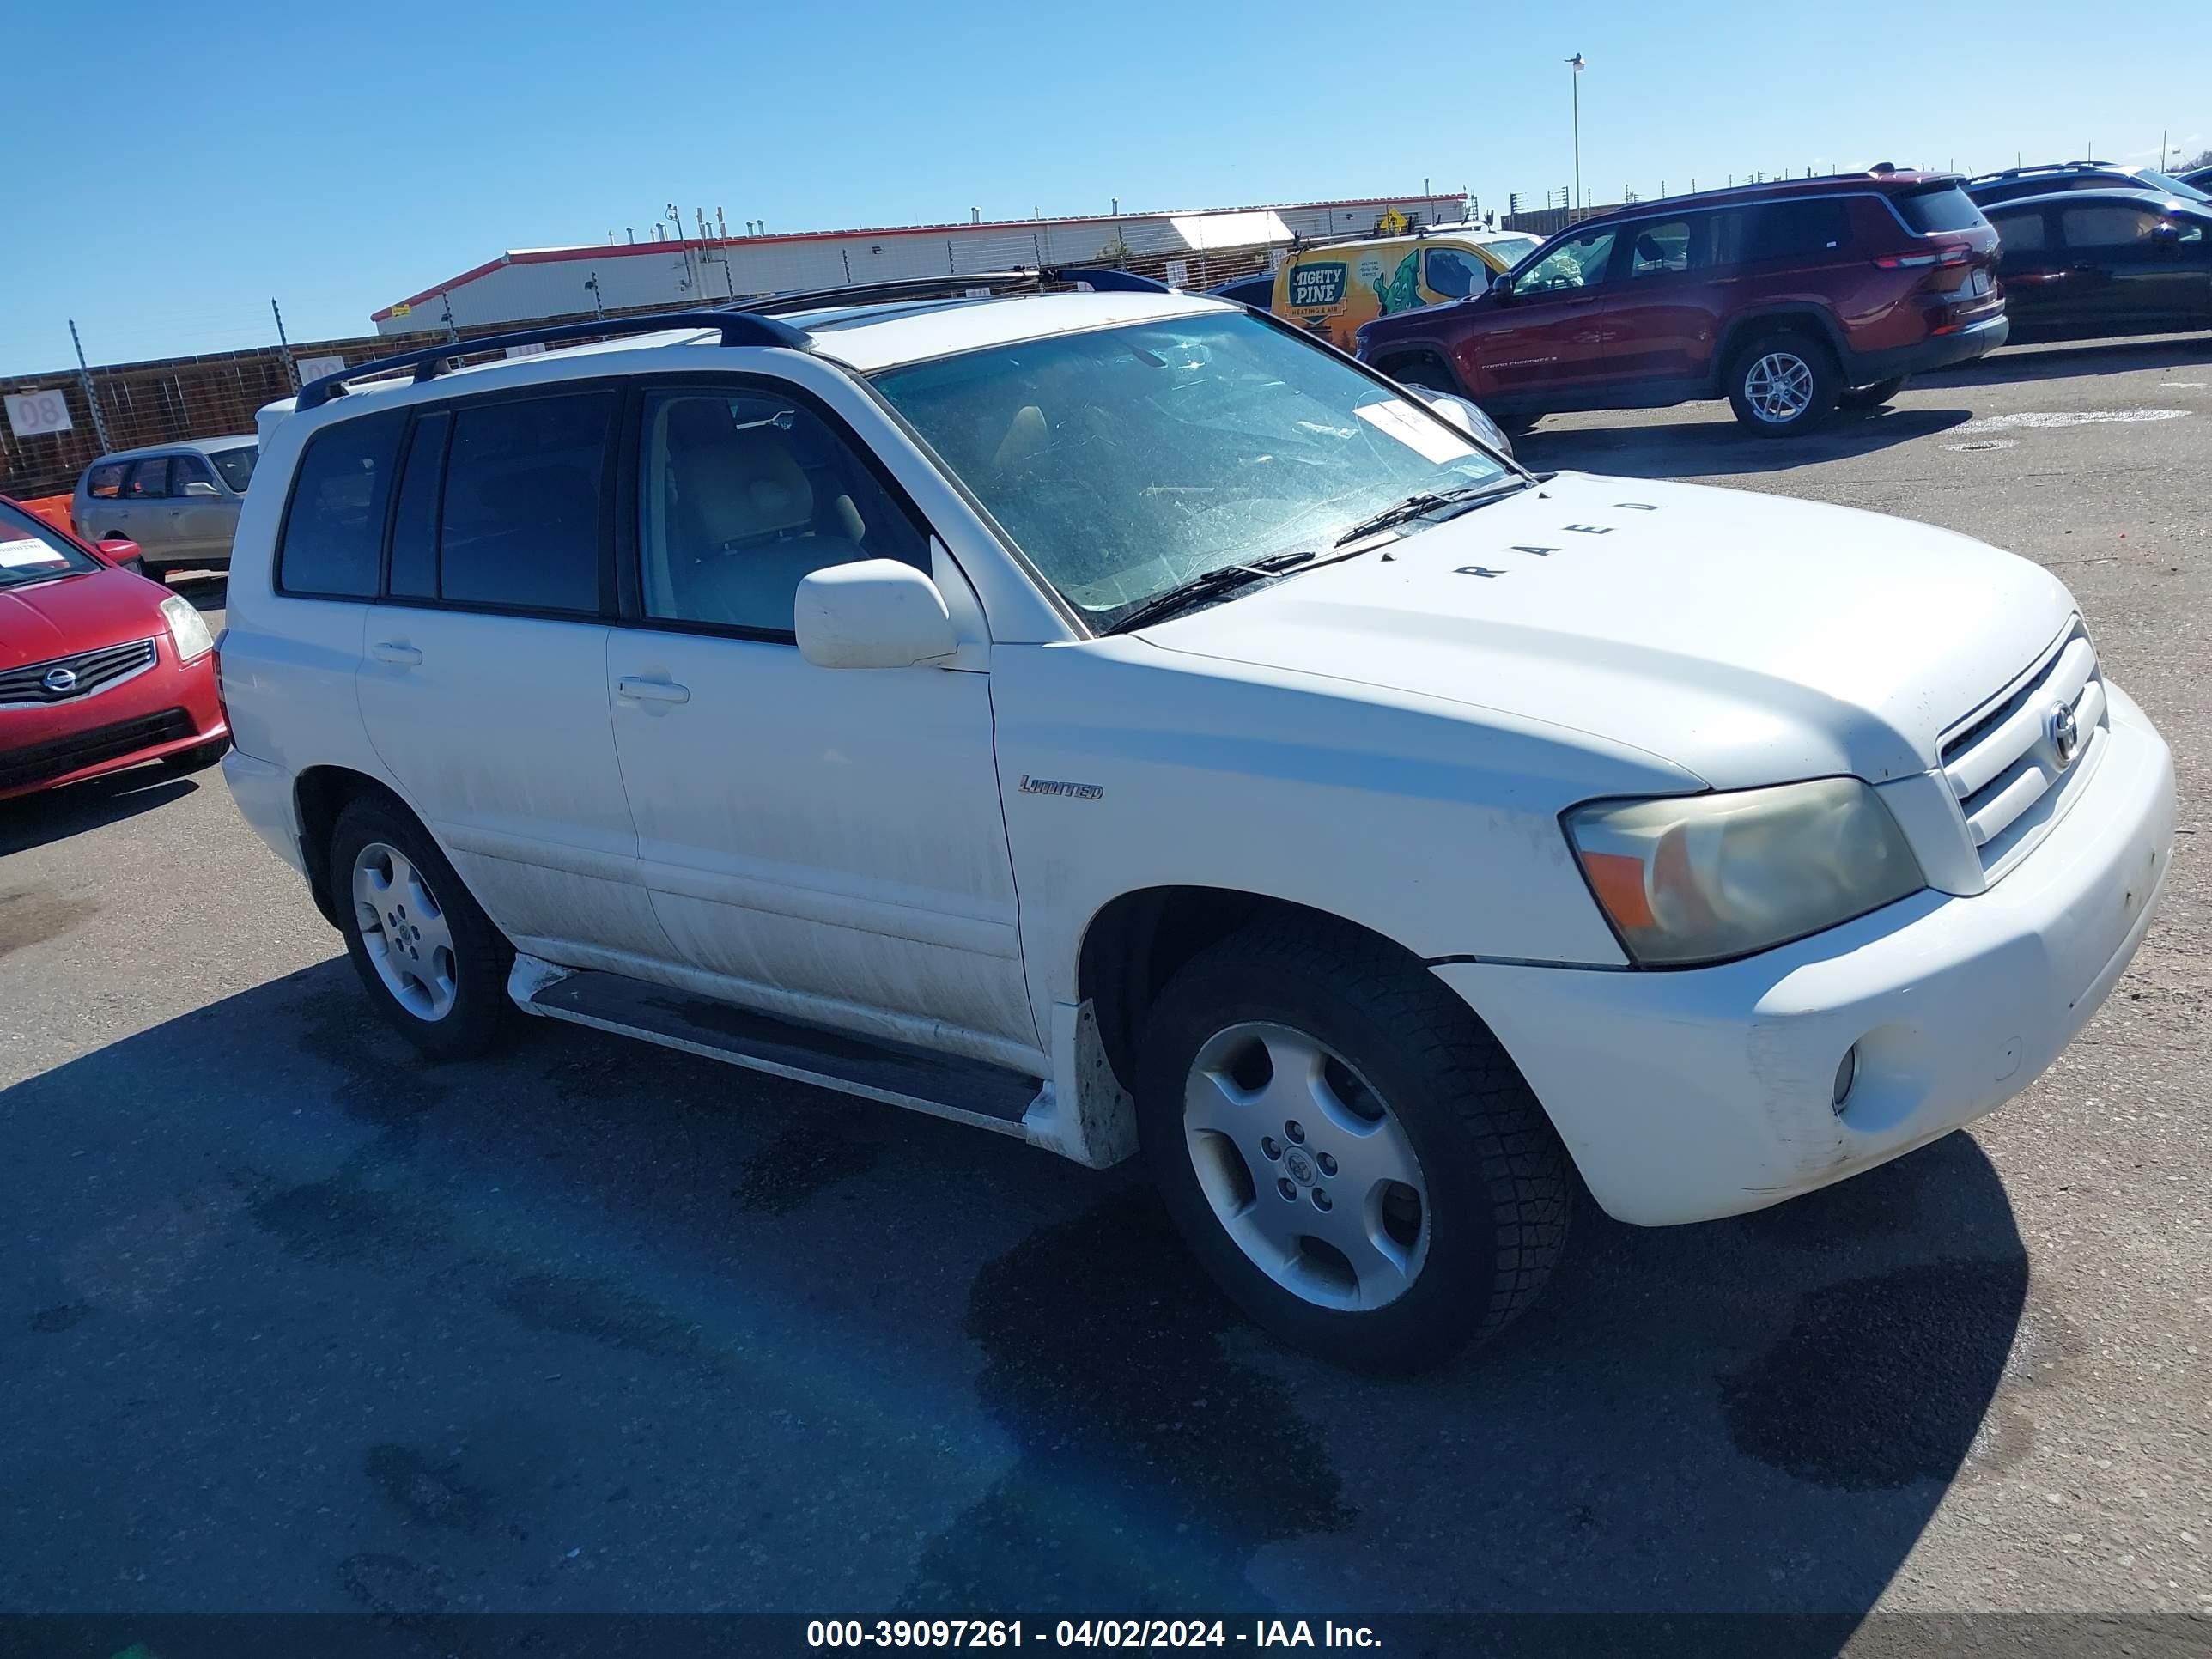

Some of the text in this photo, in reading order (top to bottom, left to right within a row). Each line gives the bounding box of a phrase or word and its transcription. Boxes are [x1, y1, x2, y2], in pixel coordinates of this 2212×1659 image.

[1293, 269, 1342, 286] MIGHTY
[1296, 284, 1335, 304] PINE
[19, 398, 59, 428] 08
